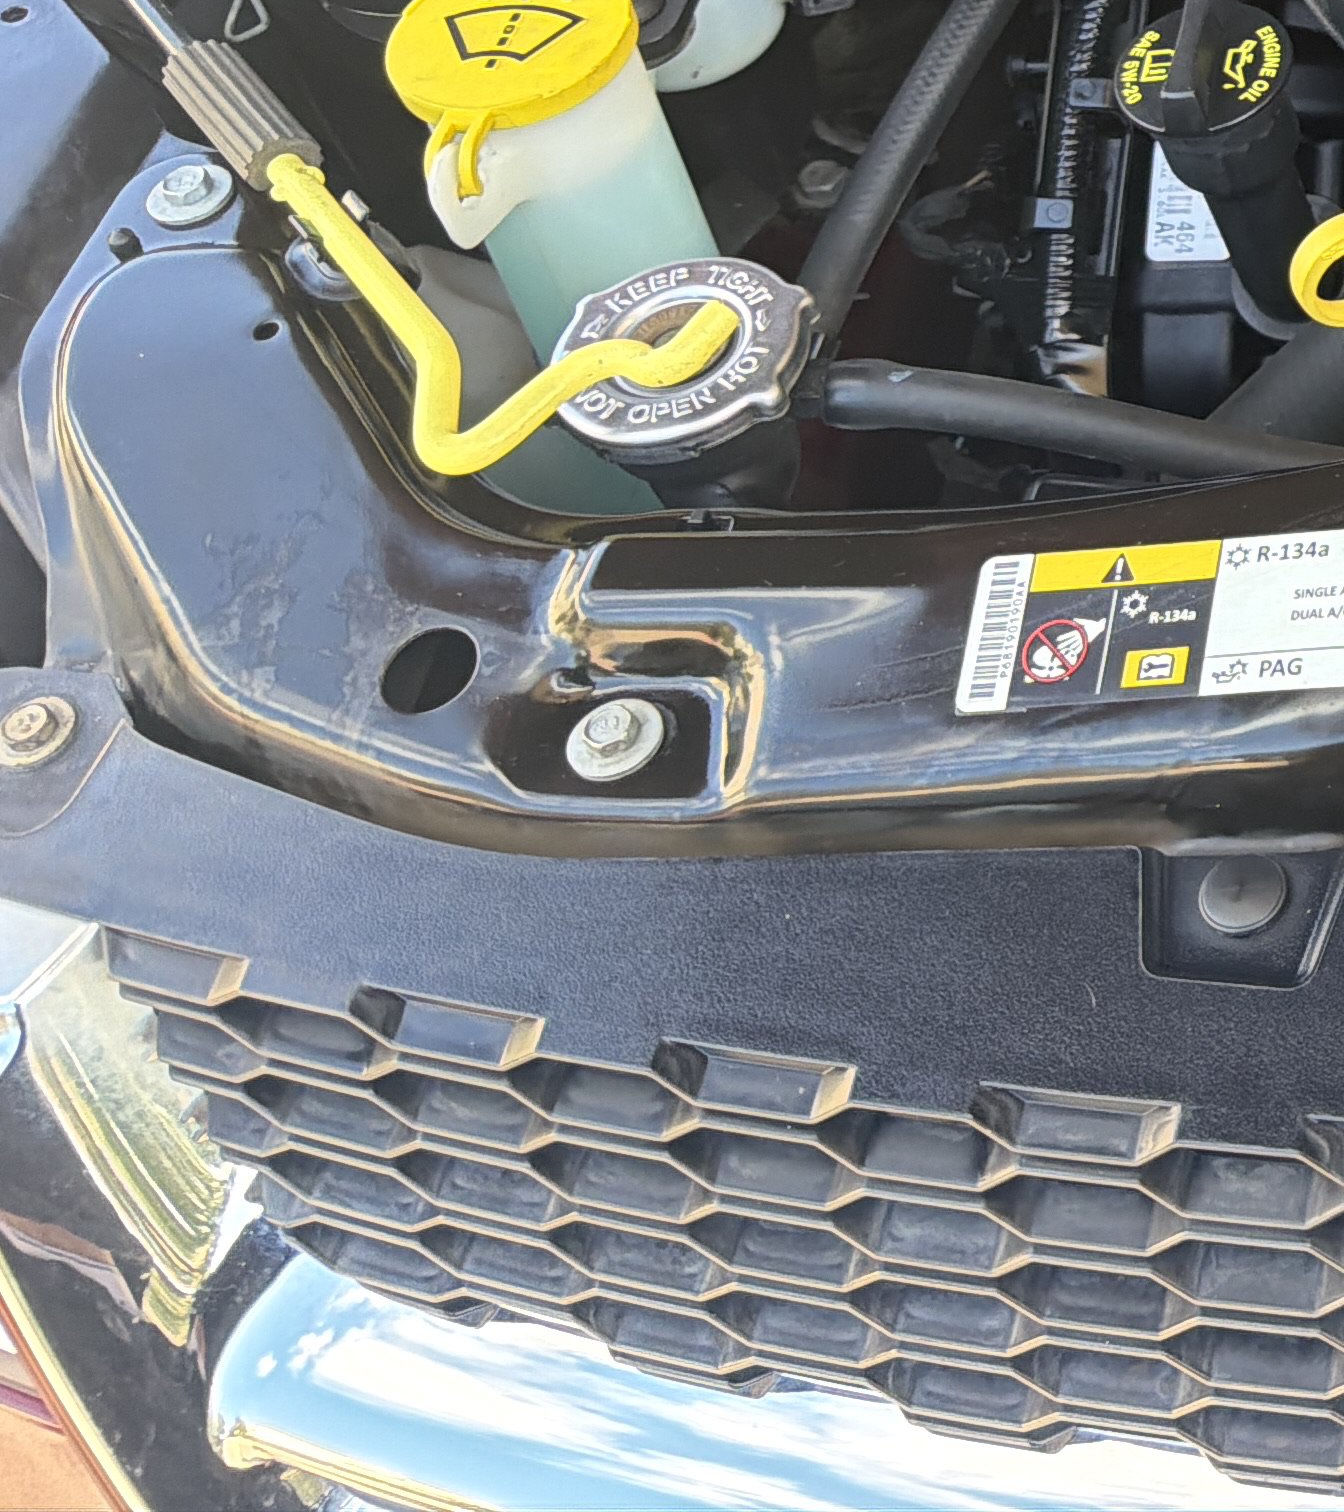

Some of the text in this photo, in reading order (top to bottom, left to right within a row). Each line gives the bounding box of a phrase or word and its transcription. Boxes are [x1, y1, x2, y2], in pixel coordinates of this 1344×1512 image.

[1121, 30, 1161, 105] SAE 5W-20
[1238, 26, 1281, 103] ENGINE OIL
[1153, 221, 1175, 248] AK
[1175, 221, 1195, 254] 464
[604, 265, 774, 312] KEEP TIGHT
[627, 388, 718, 424] OPEN
[717, 344, 770, 392] HOT
[1256, 540, 1330, 563] R-134a
[1294, 585, 1337, 599] SINGLE
[1148, 609, 1196, 624] R-134a
[1291, 607, 1324, 621] DUAL
[1259, 657, 1303, 678] PAG
